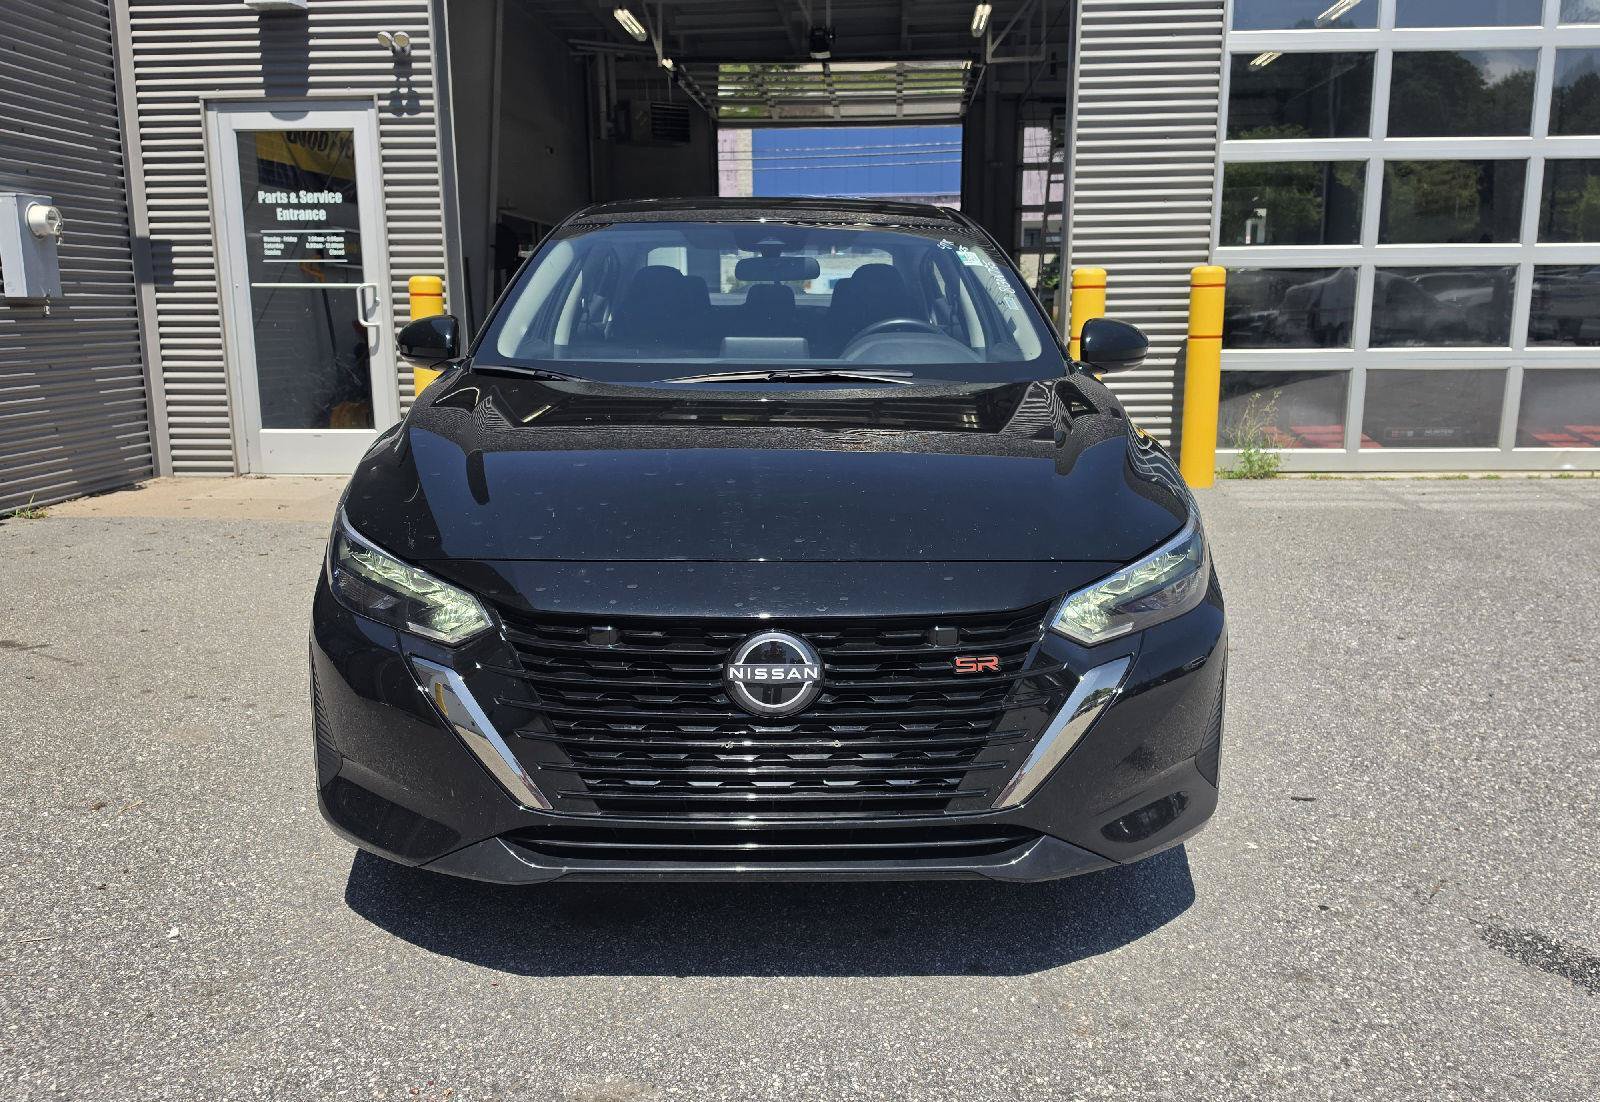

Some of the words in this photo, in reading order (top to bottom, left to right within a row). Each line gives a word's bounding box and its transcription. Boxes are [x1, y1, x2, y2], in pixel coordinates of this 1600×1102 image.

[257, 190, 289, 204] Parts
[289, 192, 299, 204] &
[299, 189, 343, 204] Service
[276, 207, 327, 221] Entrance
[955, 656, 1000, 673] SR
[729, 667, 818, 680] NISSAN
